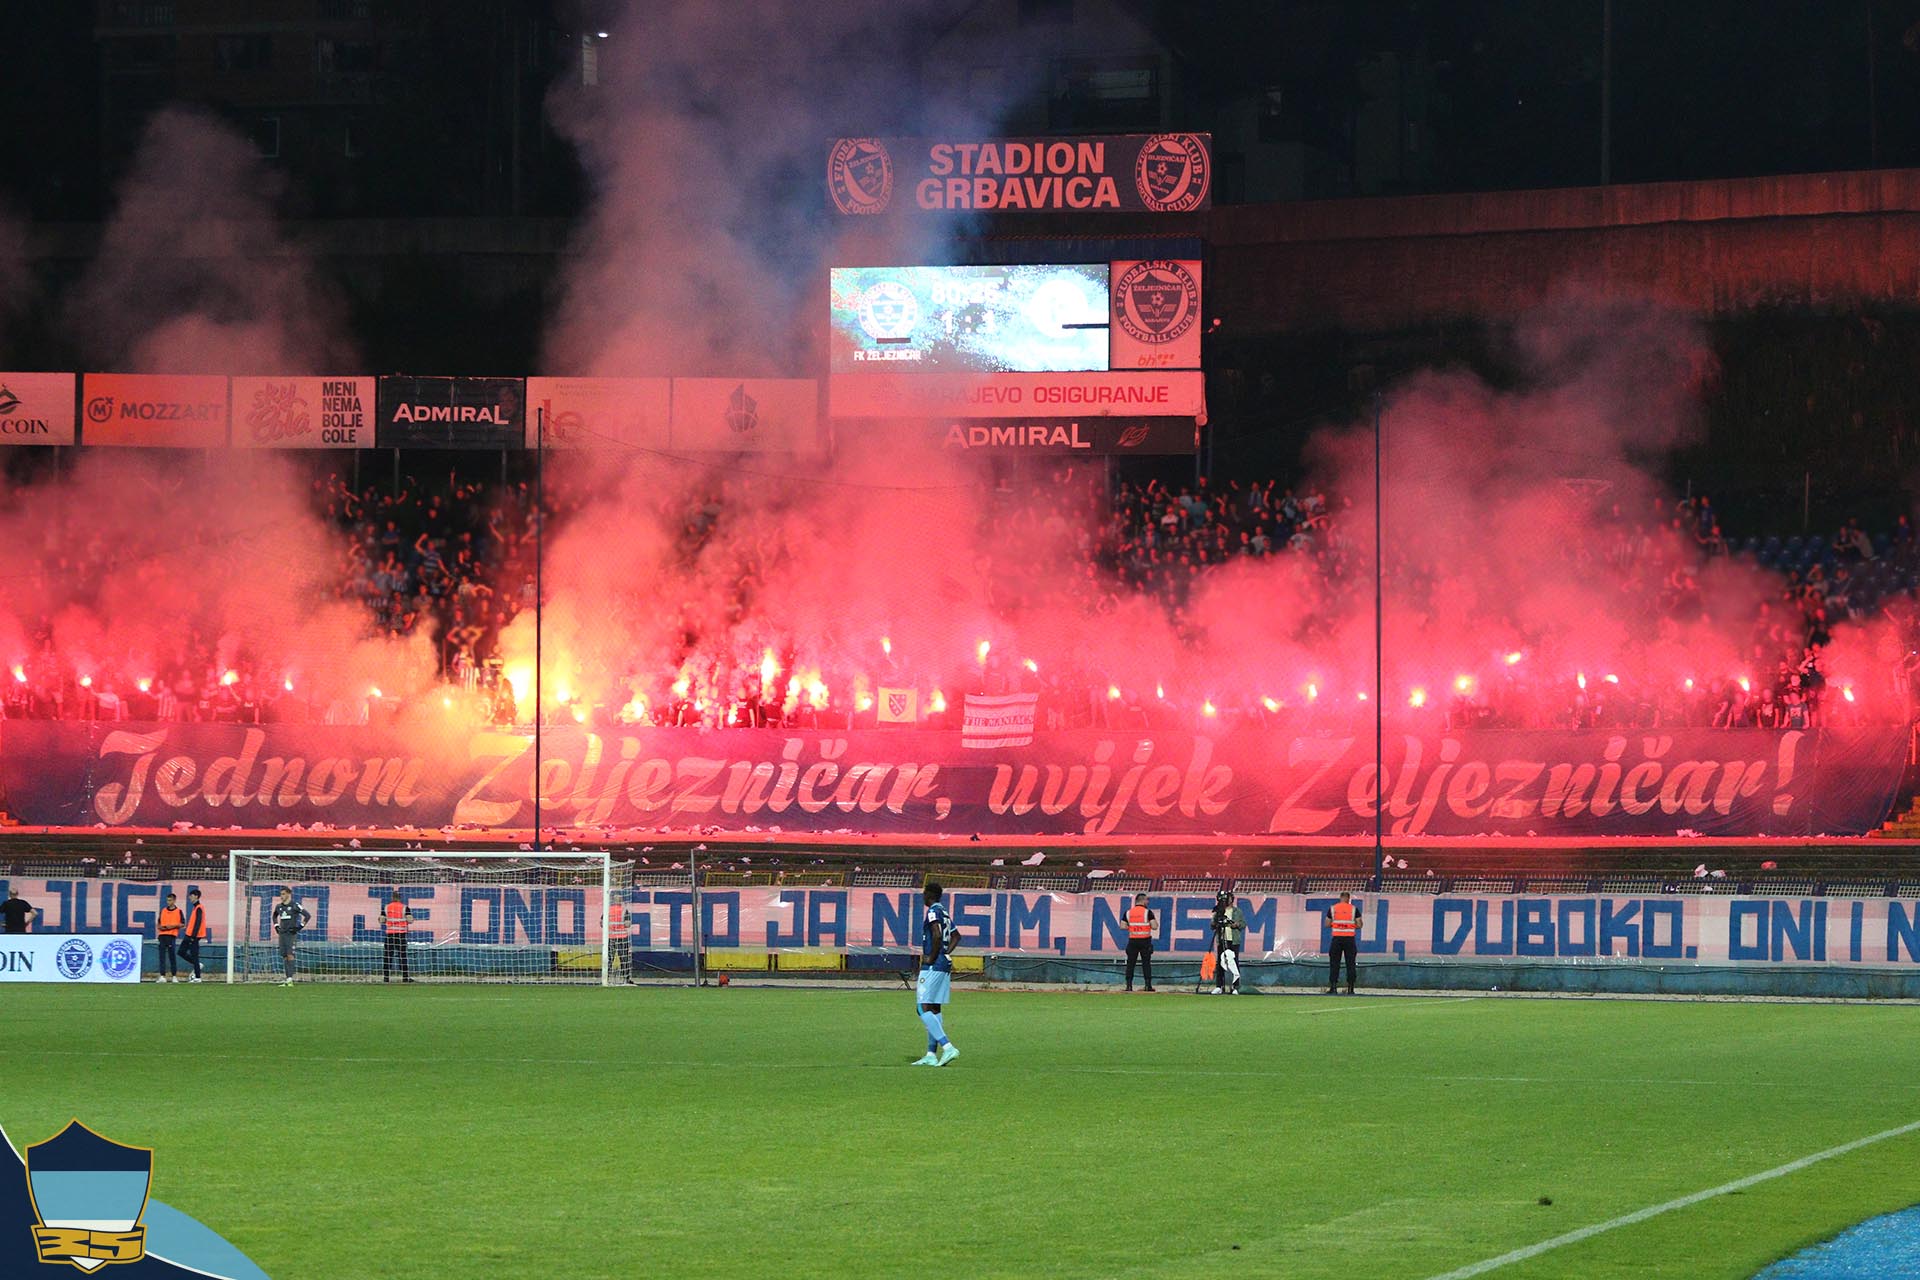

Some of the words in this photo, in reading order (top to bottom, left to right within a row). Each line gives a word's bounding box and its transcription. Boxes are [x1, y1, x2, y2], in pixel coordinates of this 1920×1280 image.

[929, 142, 1105, 176] STADION
[915, 176, 1121, 210] GRBAVICA
[1117, 260, 1173, 298] FUDBALSKI
[1176, 268, 1198, 299] KLUB
[1120, 314, 1170, 343] FOOTBALL
[1170, 314, 1195, 340] CLUB
[854, 351, 865, 361] FK
[322, 381, 357, 397] MENI
[1033, 385, 1169, 404] OSIGURANJE
[119, 402, 223, 421] MOZZART
[321, 397, 362, 413] NEMA
[392, 402, 510, 425] ADMIRAL
[321, 413, 363, 428] BOLJE
[321, 429, 357, 444] COLE
[944, 423, 1091, 449] ADMIRAL
[965, 715, 986, 728] THE
[94, 727, 428, 826] Jednom
[988, 736, 1236, 835] uvijek
[352, 886, 435, 944] JE
[459, 887, 586, 946] ONO
[766, 890, 848, 948] JA
[1090, 896, 1278, 952] NOSM
[1431, 898, 1698, 959] DUBOKO.
[1728, 899, 1828, 962] ONI
[1850, 901, 1864, 962] I
